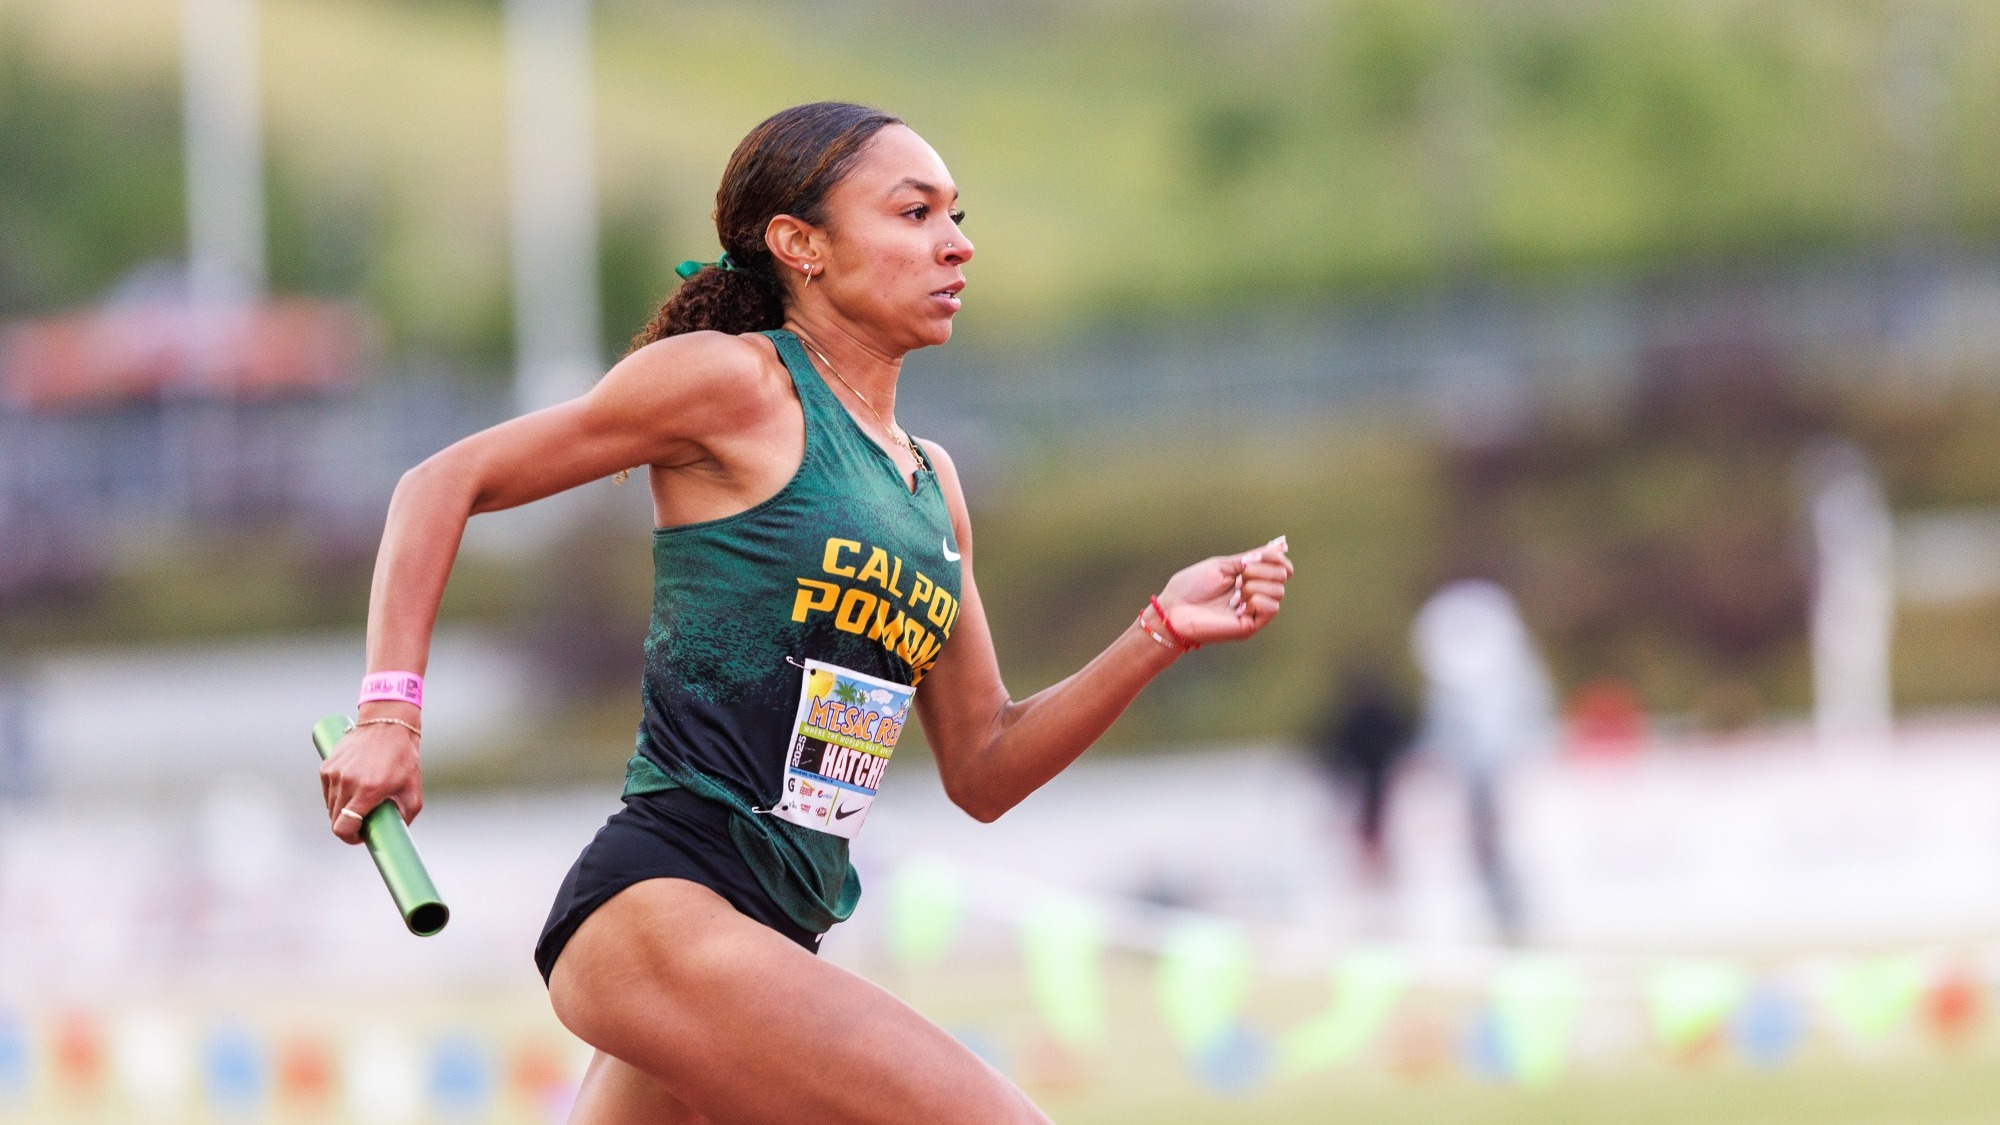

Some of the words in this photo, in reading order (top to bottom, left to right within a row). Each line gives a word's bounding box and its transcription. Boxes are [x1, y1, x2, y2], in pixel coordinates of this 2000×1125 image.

[822, 537, 903, 599] CAL
[908, 571, 961, 640] POL
[791, 734, 807, 768] 2025
[803, 725, 826, 739] WHERE
[827, 732, 839, 743] THE
[839, 736, 865, 750] WORLD'S
[865, 743, 880, 754] BEST
[788, 777, 796, 793] G
